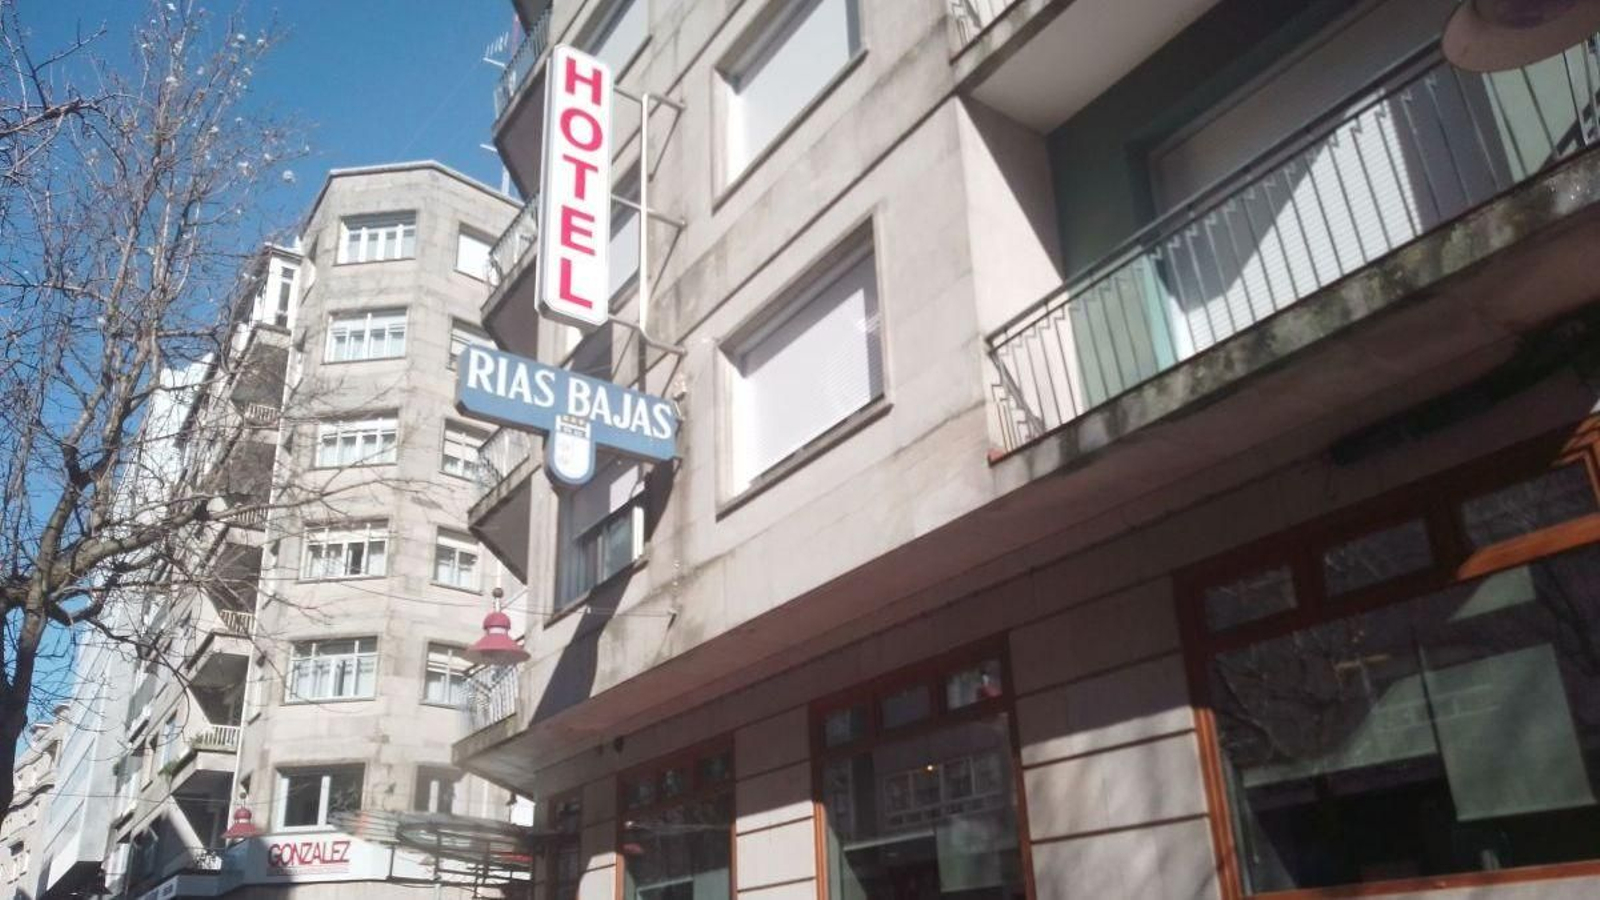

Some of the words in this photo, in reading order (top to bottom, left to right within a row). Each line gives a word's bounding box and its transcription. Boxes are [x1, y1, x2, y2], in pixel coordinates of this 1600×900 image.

[560, 56, 604, 309] HOTEL
[467, 349, 555, 408] RIAS
[568, 376, 672, 439] BAJAS
[268, 841, 350, 867] GONZALEZ
